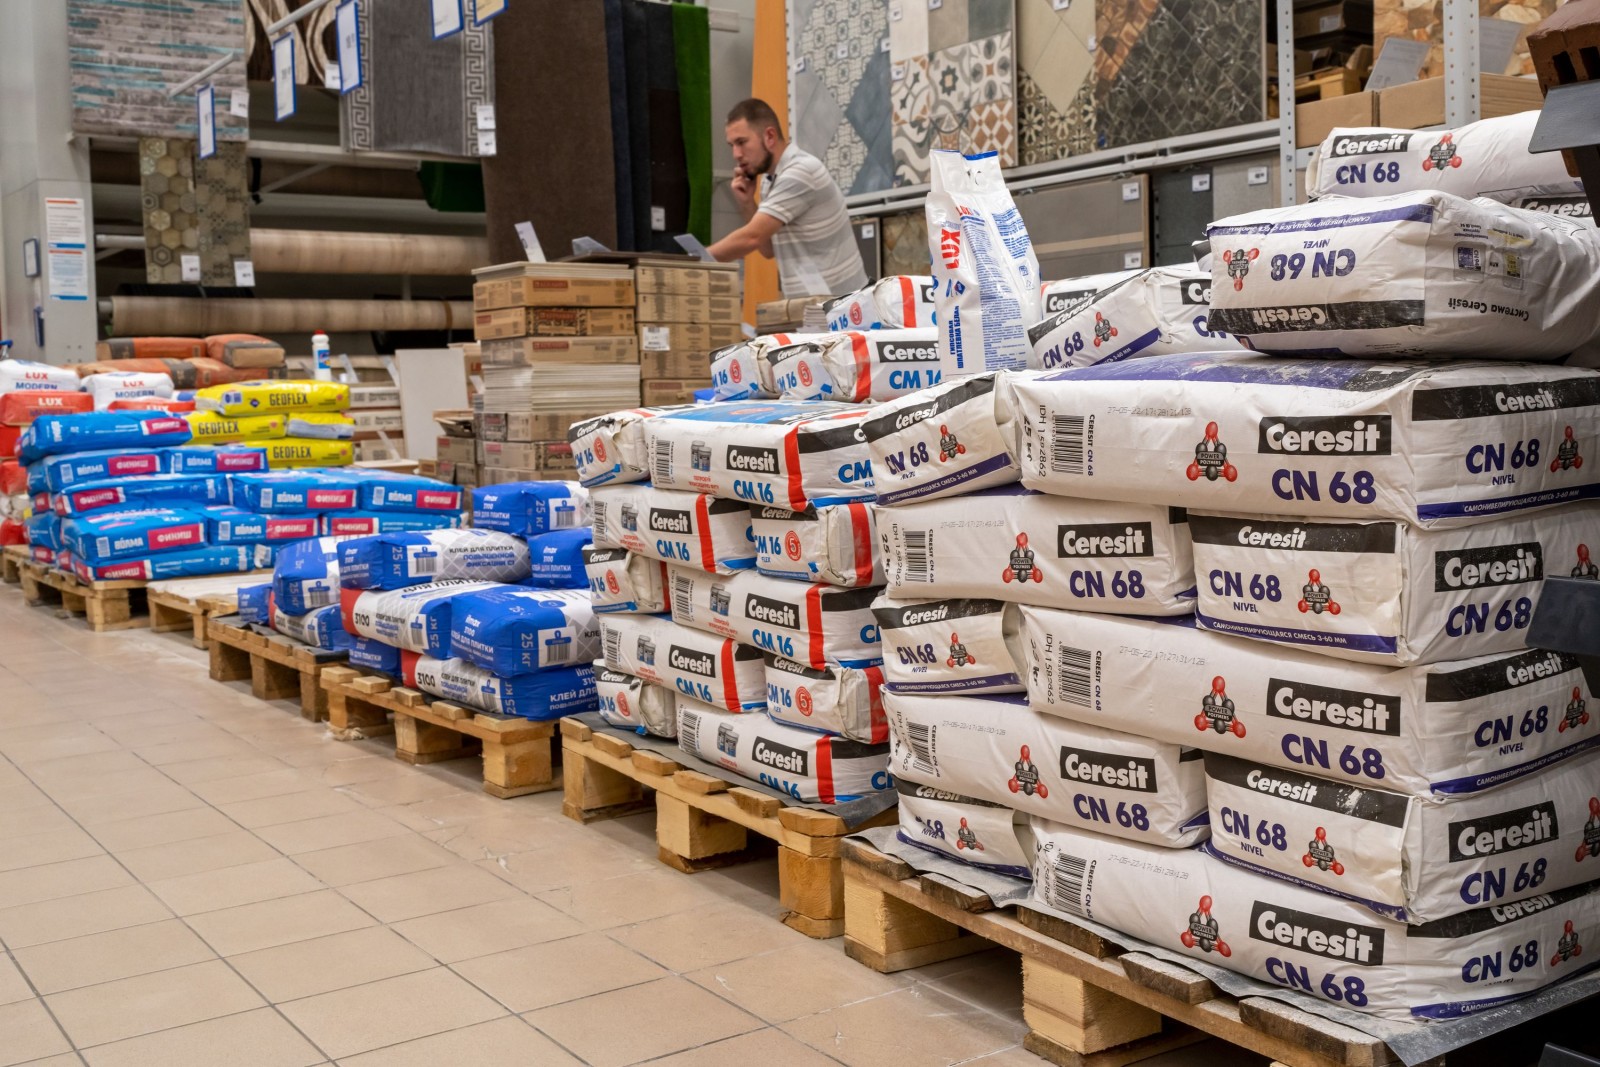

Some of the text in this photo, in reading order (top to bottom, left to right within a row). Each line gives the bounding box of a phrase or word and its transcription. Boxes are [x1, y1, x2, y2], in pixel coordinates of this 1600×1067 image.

[1336, 135, 1404, 155] Ceresit
[1336, 161, 1400, 184] CN 68
[941, 229, 961, 270] LUX
[1303, 238, 1330, 249] NIVEL
[1270, 248, 1356, 281] CN 68
[1448, 297, 1488, 313] Ceresit
[838, 314, 849, 329] 16
[1253, 306, 1327, 328] Ceresit
[1043, 331, 1084, 369] CN 68
[25, 372, 48, 380] LUX
[123, 380, 145, 388] LUX
[718, 369, 728, 385] 16
[786, 371, 797, 387] 16
[889, 370, 921, 389] CM
[38, 397, 63, 406] LUX
[115, 390, 155, 398] MODERN
[269, 393, 308, 406] GEOFLEX
[1495, 388, 1555, 413] Ceresit
[895, 402, 938, 430] Ceresit
[1039, 404, 1047, 424] IDH
[198, 421, 239, 435] GEOFLEX
[1266, 420, 1381, 452] Ceresit
[273, 446, 312, 459] GEOFLEX
[1087, 414, 1096, 476] CERESIT CN 68
[584, 448, 594, 465] 16
[729, 450, 775, 471] Ceresit
[884, 441, 930, 476] CN 68
[1466, 439, 1540, 474] CN 68
[838, 460, 873, 483] CM
[733, 480, 756, 501] CM
[757, 482, 774, 504] 16
[1271, 468, 1377, 504] CN 68
[535, 500, 546, 514] 25
[336, 523, 369, 532] ФИНИШ
[651, 511, 689, 533] Ceresit
[157, 531, 192, 543] ФИНИШ
[770, 536, 781, 555] 16
[881, 534, 890, 556] 25
[1063, 527, 1145, 555] Ceresit
[1238, 526, 1307, 548] Ceresit
[392, 547, 403, 560] 25
[656, 539, 675, 559] CM
[676, 541, 691, 562] 16
[929, 559, 934, 572] CN
[1443, 549, 1536, 587] Ceresit
[596, 576, 606, 592] 16
[929, 573, 935, 584] 68
[1069, 570, 1146, 599] CN 68
[1209, 569, 1282, 603] CN 68
[748, 599, 795, 626] Ceresit
[902, 605, 949, 626] Ceresit
[1233, 601, 1259, 613] NIVEL
[1445, 596, 1532, 637] CN 68
[431, 633, 440, 648] 25
[521, 633, 534, 648] 25
[752, 629, 794, 657] CM 16
[1293, 632, 1316, 641] СМЕСЬ
[1317, 634, 1334, 643] 3-60
[671, 650, 712, 675] Ceresit
[896, 643, 937, 665] CN 68
[773, 657, 805, 674] Ceresit
[1506, 652, 1563, 686] Ceresit
[417, 672, 436, 687] 3100
[676, 677, 713, 703] CM 16
[550, 689, 577, 702] КЛЕЙ
[606, 694, 616, 712] 16
[780, 685, 792, 708] 16
[1095, 685, 1101, 700] CN
[505, 699, 517, 715] 25
[1096, 701, 1102, 711] 68
[1207, 706, 1228, 714] POWER
[1274, 687, 1389, 731] Ceresit
[1474, 705, 1549, 748] CN 68
[755, 742, 804, 772] Ceresit
[1281, 733, 1386, 780] CN 68
[1499, 742, 1524, 756] NIVEL
[932, 754, 939, 767] CN
[1065, 753, 1148, 789] Ceresit
[1246, 770, 1318, 803] Ceresit
[1073, 793, 1150, 832] CN 68
[1220, 806, 1288, 852] CN 68
[1457, 810, 1552, 856] Ceresit
[1240, 841, 1264, 857] NIVEL
[1084, 859, 1097, 908] CERESIT CN
[1460, 858, 1548, 904] CN 68
[1193, 925, 1213, 935] POWER
[1257, 910, 1373, 962] Ceresit
[1462, 939, 1539, 983] CN 68
[1266, 956, 1368, 1007] CN 68
